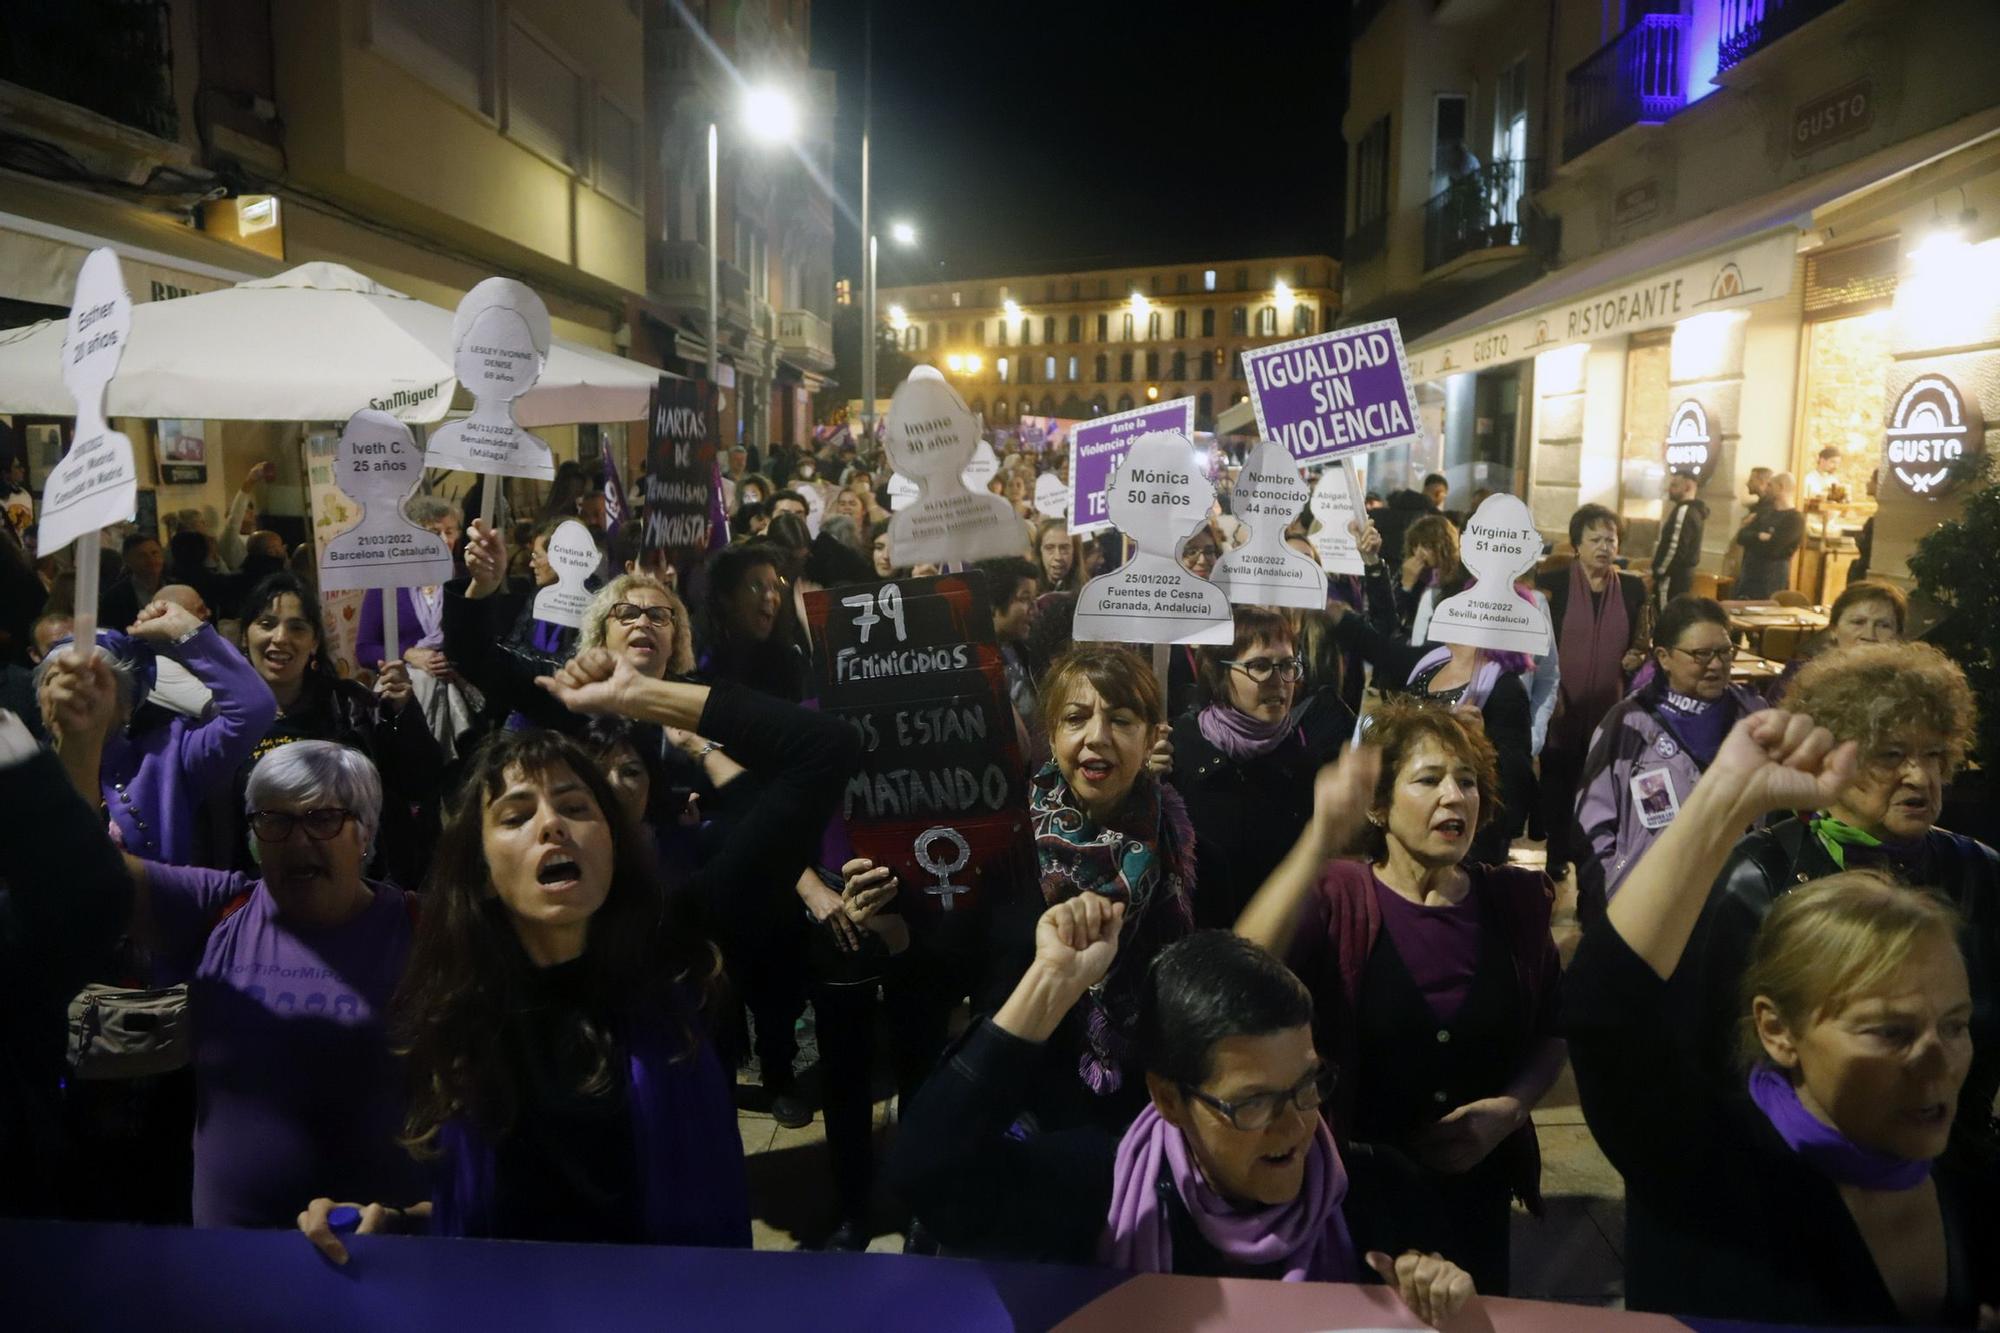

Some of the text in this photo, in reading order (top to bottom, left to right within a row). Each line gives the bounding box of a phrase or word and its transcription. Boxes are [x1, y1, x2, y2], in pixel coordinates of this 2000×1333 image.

[1797, 94, 1866, 142] GUSTO
[77, 300, 116, 332] Esther
[1567, 279, 1684, 339] RISTORANTE
[87, 330, 118, 354] años
[1474, 334, 1509, 363] GUSTO
[470, 345, 532, 360] LESLEY IVONNE
[484, 359, 512, 370] DENISE
[1258, 333, 1390, 391] IGUALDAD
[495, 374, 515, 383] años
[1310, 375, 1355, 415] SIN
[656, 404, 707, 440] HARTAS
[904, 416, 952, 438] Imane
[1110, 422, 1135, 435] Ante
[1136, 418, 1147, 430] la
[1271, 400, 1410, 455] VIOLENCIA
[352, 442, 386, 455] Iveth
[390, 442, 405, 455] C.
[927, 433, 960, 455] años
[1080, 438, 1125, 457] Violencia
[1126, 433, 1137, 446] d
[1888, 438, 1963, 463] GUSTO
[674, 442, 691, 467] DE
[1665, 445, 1708, 465] GUSTO
[353, 460, 407, 472] 25 años
[1131, 469, 1189, 485] Mónica
[1248, 472, 1295, 485] Nombre
[1127, 491, 1190, 505] 50 años
[1235, 488, 1307, 502] no conocido
[1318, 492, 1347, 500] Abigail
[1246, 504, 1292, 516] 44 años
[1333, 502, 1355, 510] años
[357, 534, 412, 546] 21/03/2022
[1471, 525, 1531, 540] Virginia T.
[330, 545, 440, 561] Barcelona (Cataluña)
[554, 545, 584, 557] Cristina
[1476, 541, 1522, 554] 51 años
[569, 559, 589, 567] años
[1241, 555, 1286, 565] 12/08/2022
[1222, 565, 1251, 575] Sevilla
[1125, 574, 1181, 585] 25/01/2022
[1107, 587, 1204, 599] Fuentes de Cesna
[1099, 600, 1151, 612] (Granada,
[1467, 600, 1513, 611] 21/06/2022
[841, 583, 908, 644] 79
[1448, 608, 1478, 619] Sevilla
[896, 695, 987, 747] ESTÁN
[843, 763, 1009, 822] MATANDO
